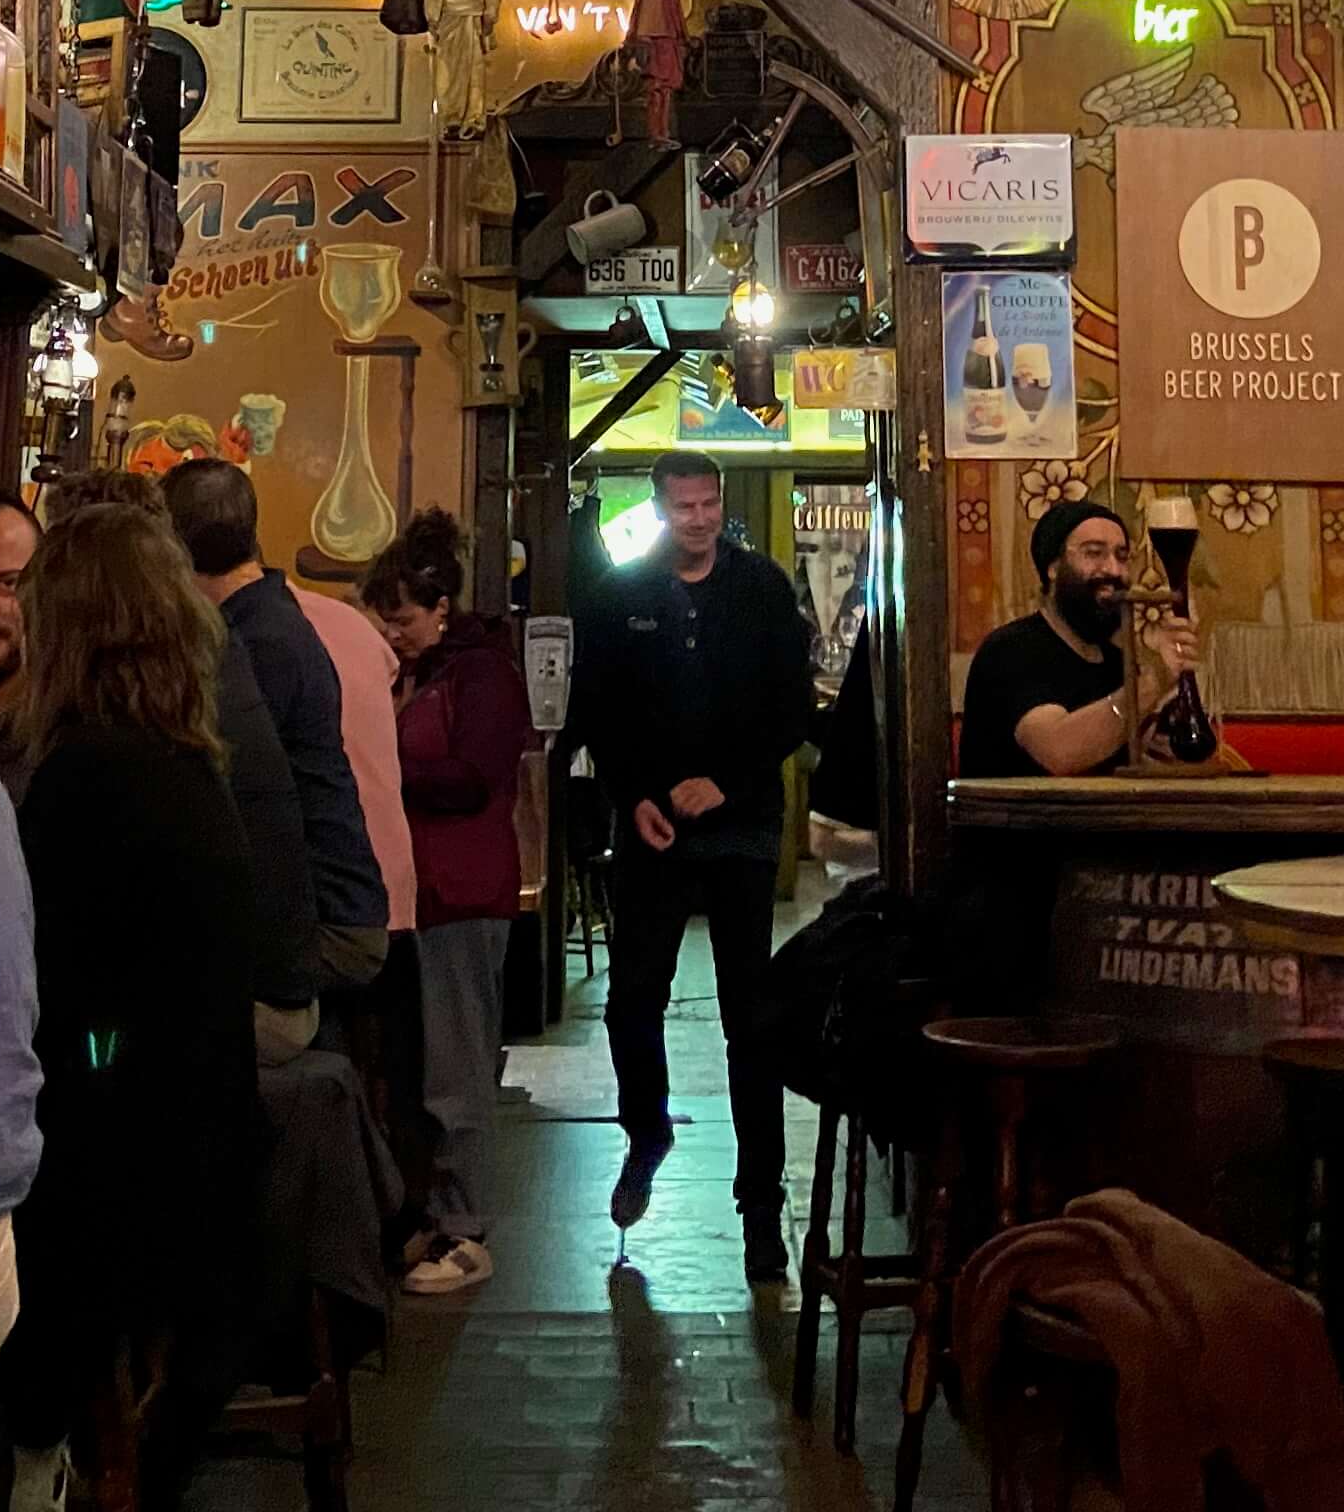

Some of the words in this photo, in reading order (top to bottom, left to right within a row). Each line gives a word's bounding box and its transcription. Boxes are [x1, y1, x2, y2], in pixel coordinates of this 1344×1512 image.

[920, 178, 1060, 202] VICARIS
[917, 214, 993, 225] BROUWERIJ
[166, 253, 271, 301] Schoen
[589, 258, 626, 282] 636
[991, 295, 1066, 308] CHOUFFE
[1190, 331, 1315, 362] BRUSSELS
[800, 363, 847, 393] WC
[1164, 369, 1222, 399] BEER
[1232, 369, 1342, 401] PROJECT
[1098, 946, 1301, 997] LINDEMANS
